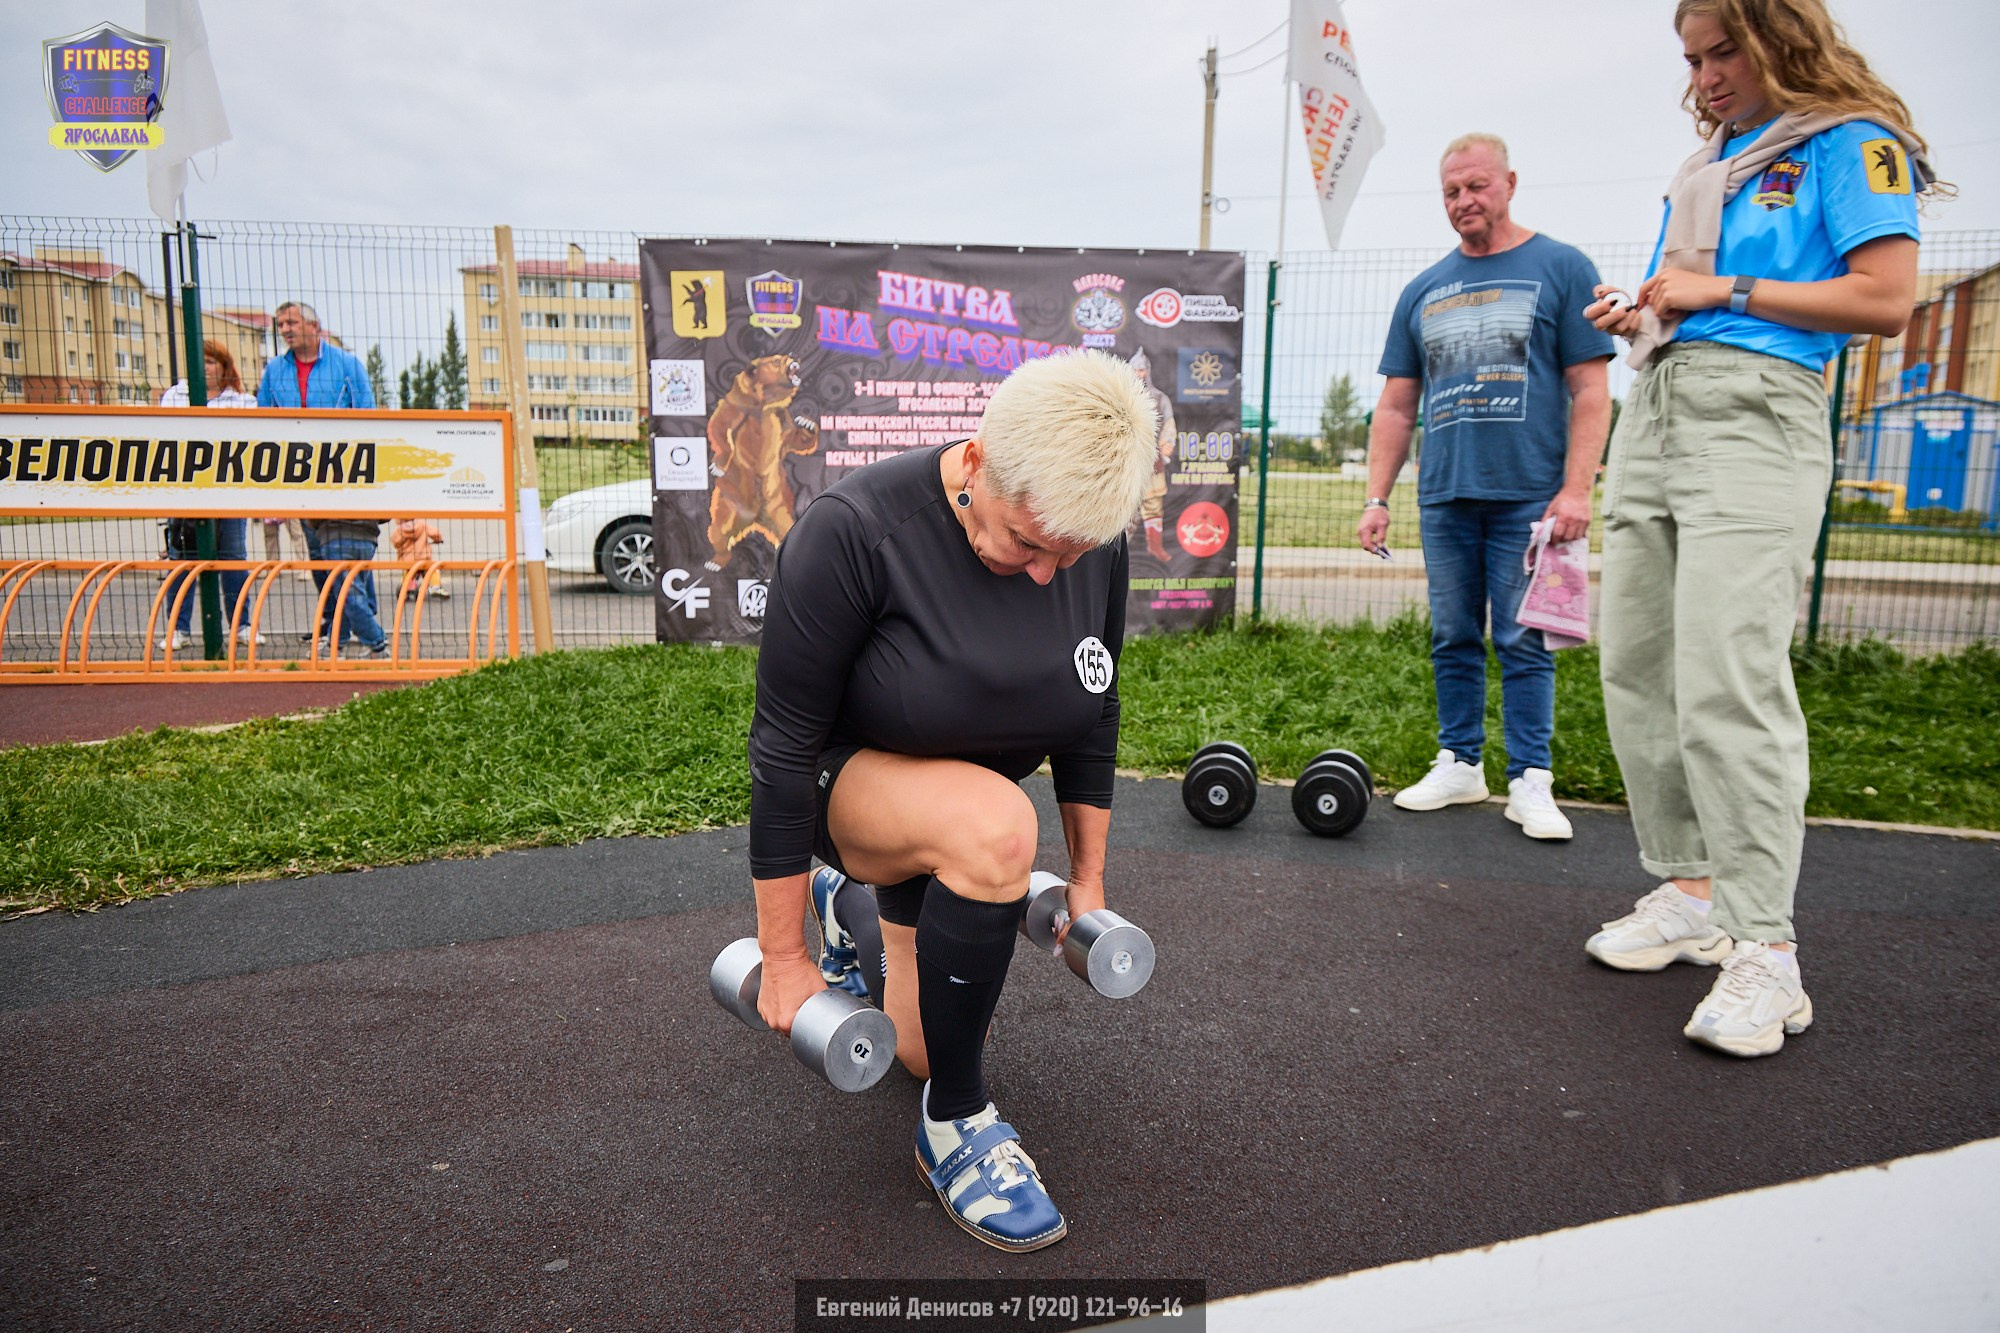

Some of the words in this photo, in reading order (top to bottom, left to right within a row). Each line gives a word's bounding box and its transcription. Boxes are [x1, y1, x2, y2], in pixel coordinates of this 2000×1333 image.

[755, 281, 794, 294] FITNESS
[878, 270, 1019, 328] БИТВА
[816, 305, 879, 349] НА
[887, 318, 1072, 374] СТРЕЛК
[1178, 431, 1234, 462] 10:00
[1078, 647, 1107, 687] 155
[854, 1043, 870, 1059] 10
